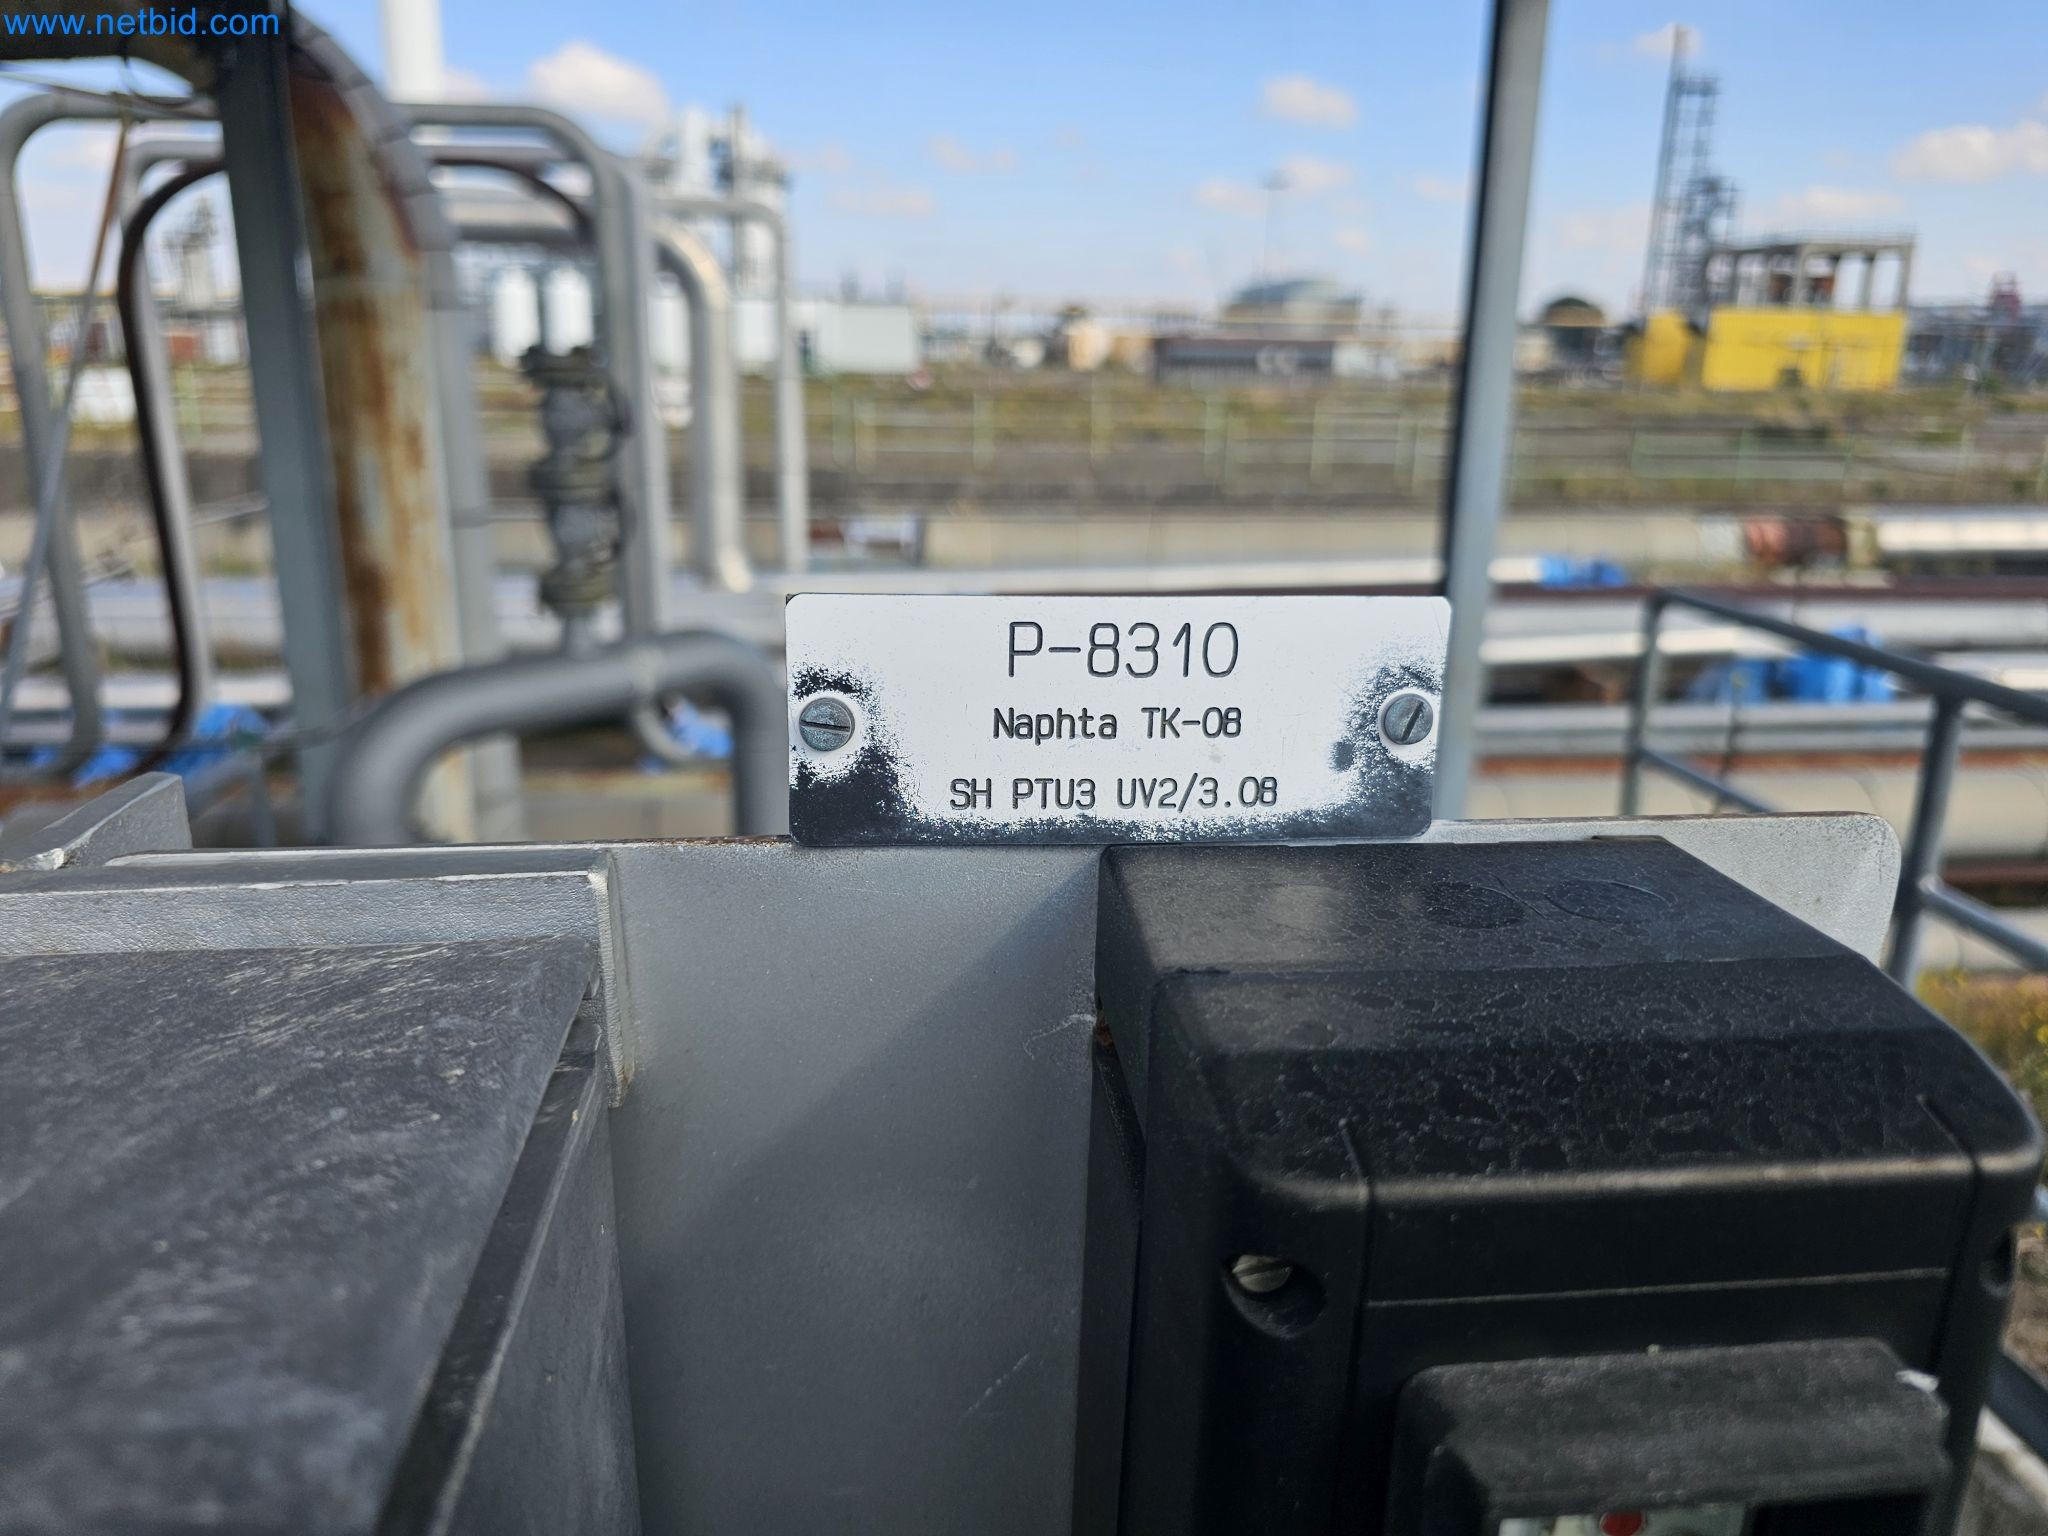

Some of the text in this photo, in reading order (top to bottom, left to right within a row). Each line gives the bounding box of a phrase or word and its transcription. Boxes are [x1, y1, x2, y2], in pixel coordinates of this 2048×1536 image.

[1007, 621, 1240, 679] P-8310
[992, 706, 1243, 747] Naphta TK-08
[949, 771, 1279, 814] SH PTU3 UV2/3.08
